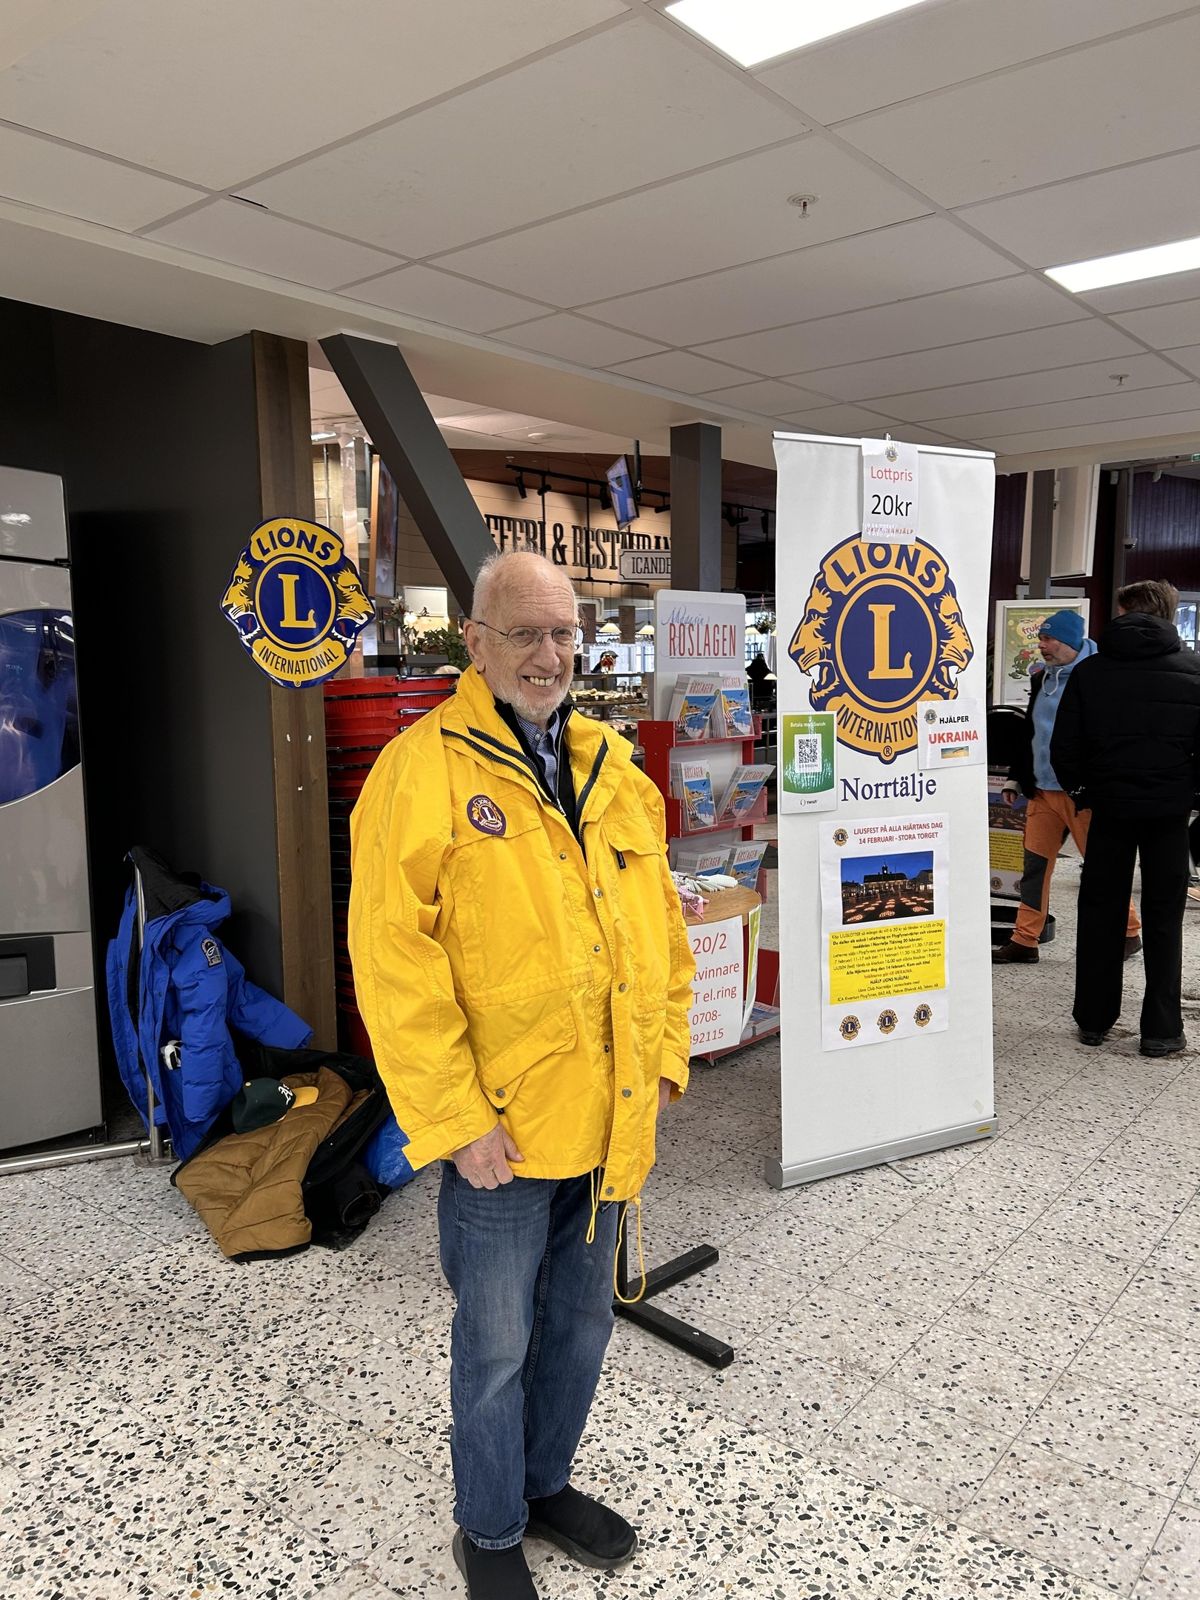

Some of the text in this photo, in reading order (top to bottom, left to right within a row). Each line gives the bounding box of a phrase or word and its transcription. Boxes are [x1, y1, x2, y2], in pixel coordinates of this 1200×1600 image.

[870, 466, 913, 483] Lottpris
[871, 494, 913, 517] 20kr
[256, 527, 335, 560] LIONS
[552, 523, 567, 565] &
[831, 543, 941, 588] LIONS
[278, 573, 317, 628] L
[669, 623, 736, 656] ROSLAGEN
[868, 604, 913, 679] L
[258, 645, 339, 675] INTERNATIONAL
[939, 715, 969, 724] HJÄLPER
[928, 730, 978, 744] UKRAINA
[840, 772, 937, 802] Norrtälje
[853, 826, 879, 835] LJUSFEST
[880, 824, 887, 833] PÅ
[867, 835, 894, 844] FEBRUARI
[898, 833, 916, 841] STORA
[917, 831, 939, 839] TORGET
[692, 932, 727, 955] 20/2
[692, 1009, 722, 1025] 0708-
[690, 1027, 724, 1045] 92115
